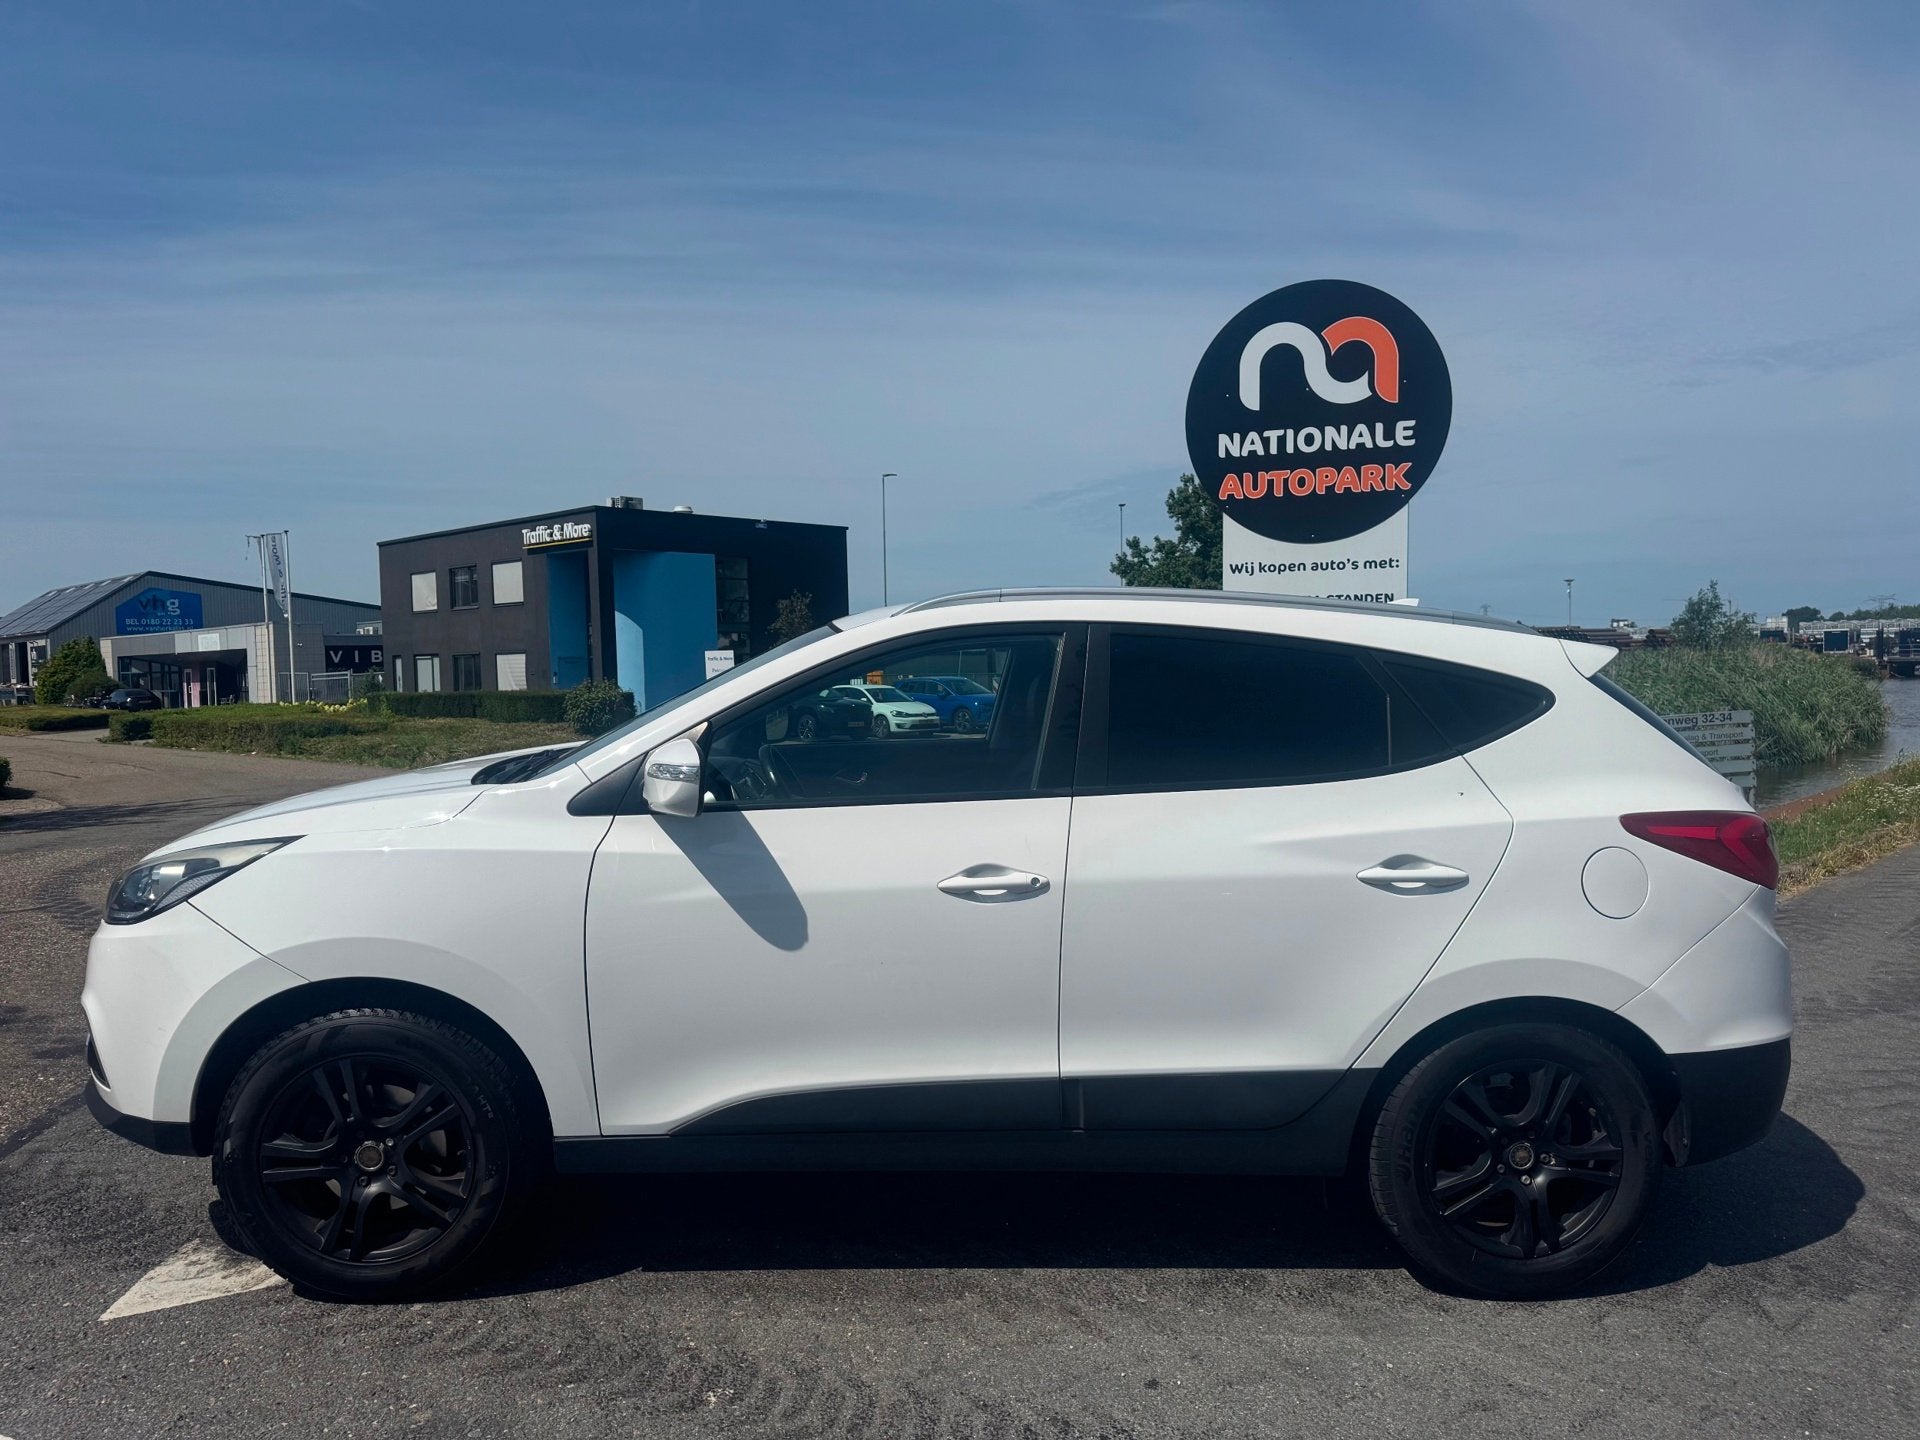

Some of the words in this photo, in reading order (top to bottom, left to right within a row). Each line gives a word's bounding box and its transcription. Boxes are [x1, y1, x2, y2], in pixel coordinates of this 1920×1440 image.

[1218, 419, 1416, 458] NATIONALE
[1218, 462, 1412, 500] AUTOPARK
[521, 525, 553, 545] Traffic
[553, 524, 564, 540] &
[563, 522, 592, 539] More
[1229, 562, 1255, 577] Wij
[1258, 561, 1306, 575] kopen
[1363, 557, 1400, 570] met:
[1702, 712, 1733, 724] 32-34
[1708, 730, 1744, 740] Transport
